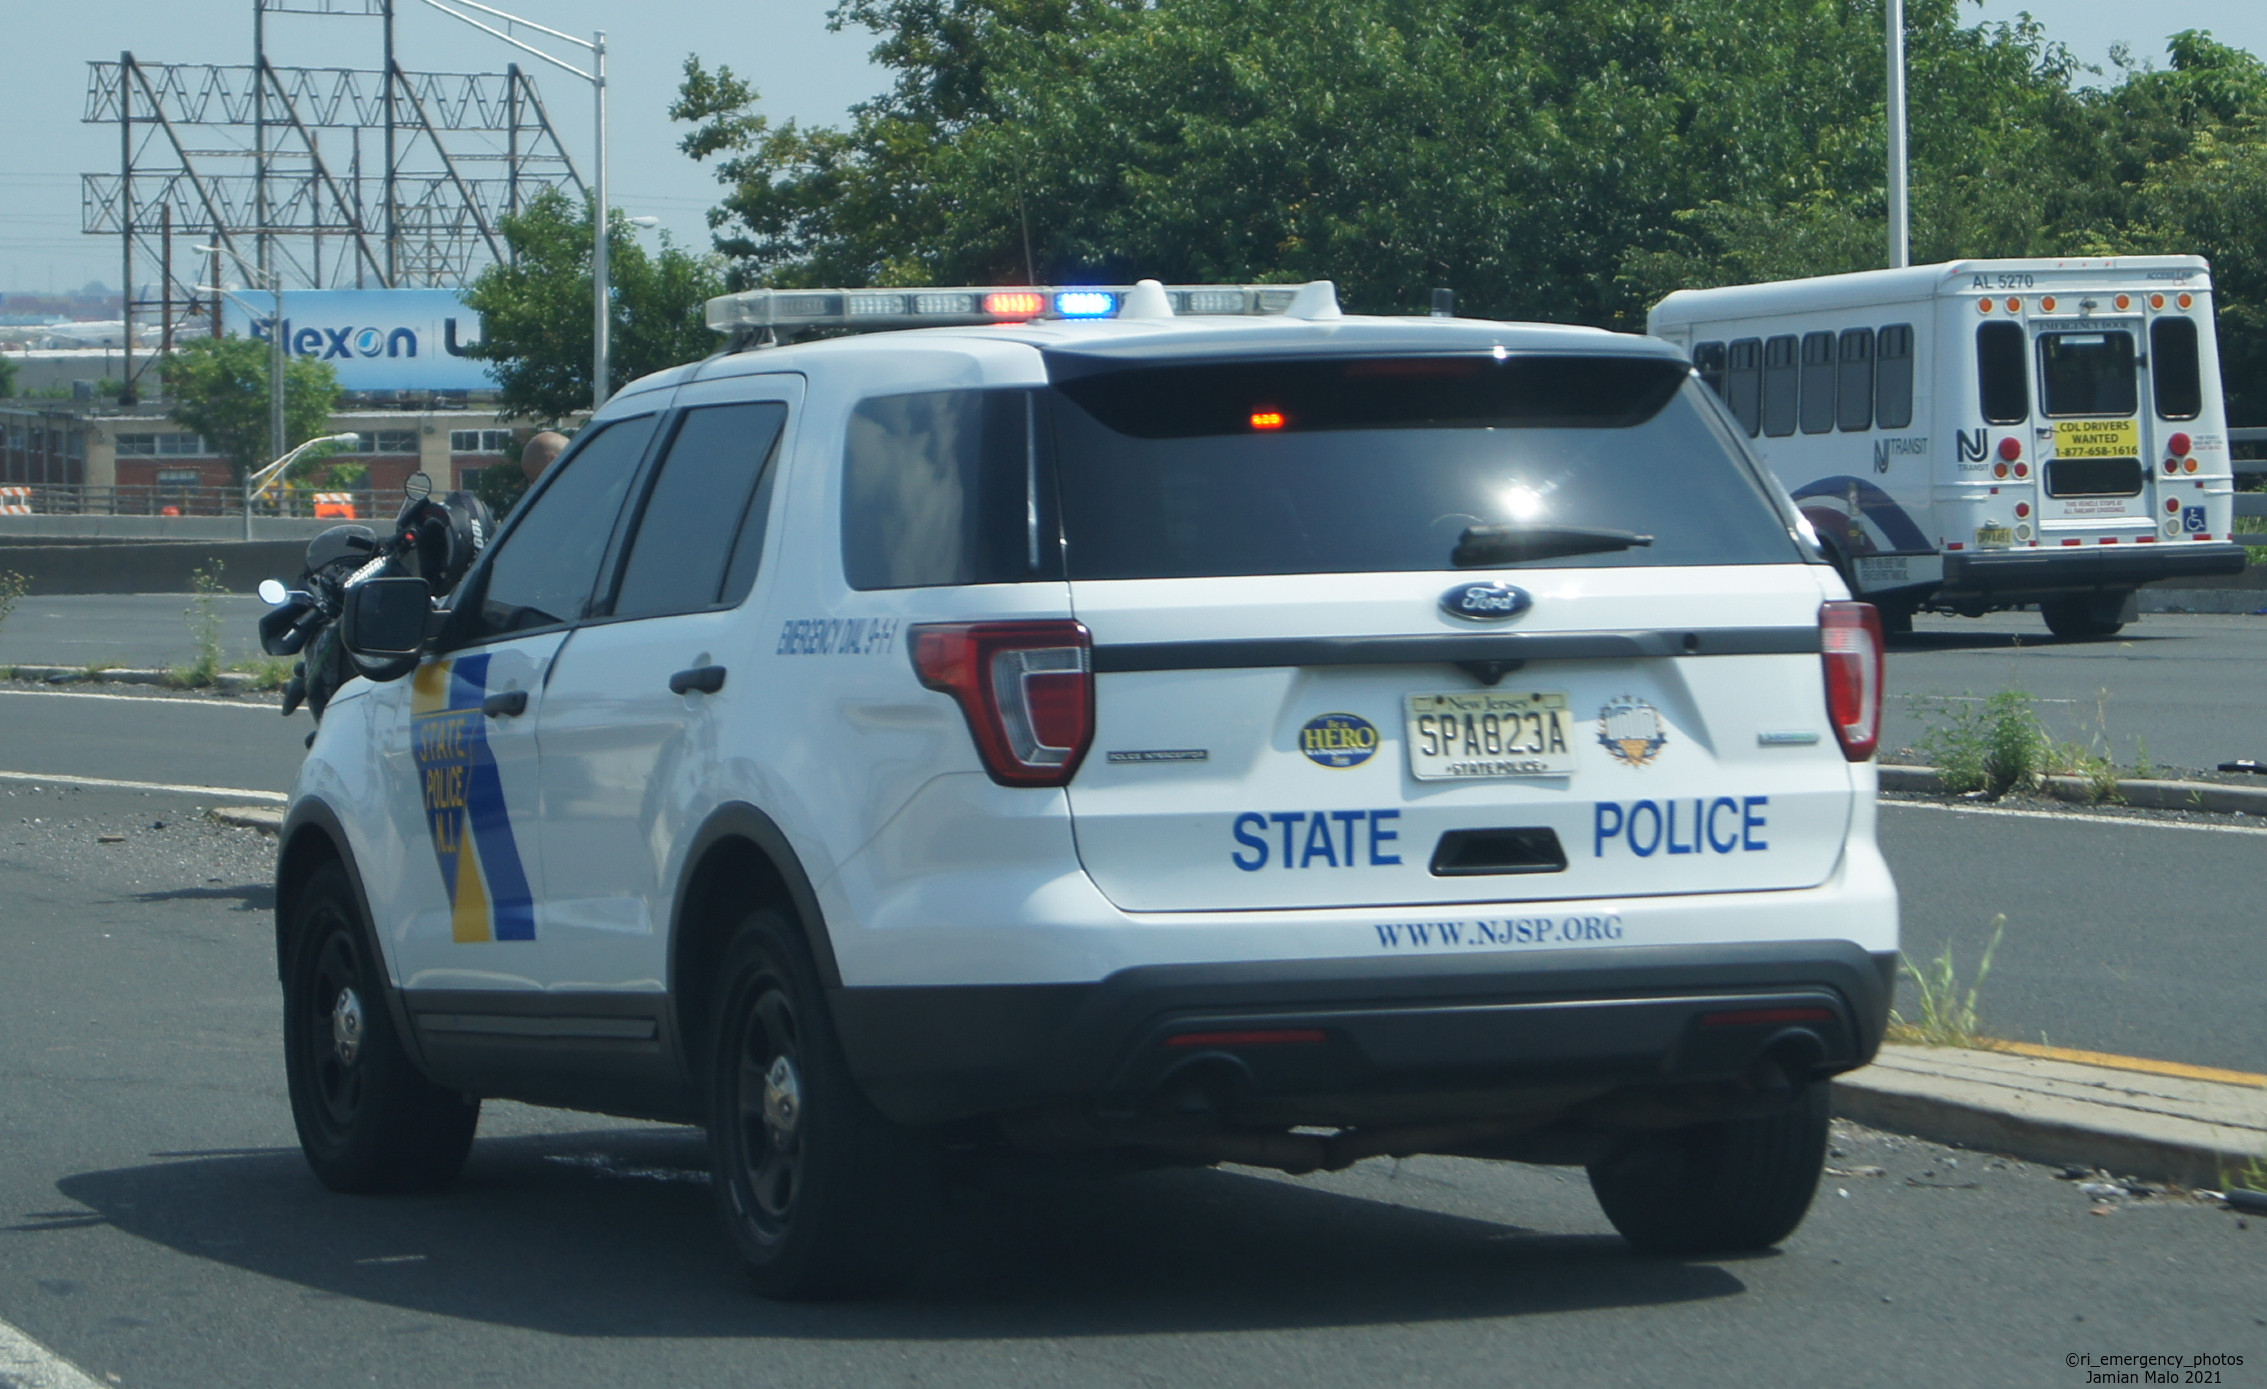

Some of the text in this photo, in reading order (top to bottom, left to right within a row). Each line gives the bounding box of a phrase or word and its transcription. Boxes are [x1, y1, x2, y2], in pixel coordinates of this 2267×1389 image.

[1972, 274, 2034, 289] AL 5270
[2060, 421, 2129, 432] CDL DRIVERS
[1890, 438, 1928, 454] TRANSIT
[2072, 434, 2118, 444] WANTED
[2055, 445, 2138, 457] 1-877-658-1616
[1461, 587, 1516, 609] Ford
[420, 718, 466, 762] STATE
[1303, 727, 1376, 749] HERO
[1418, 711, 1567, 756] SPA823A
[1452, 759, 1543, 775] STATE POLICE
[426, 766, 464, 809] POLICE
[1231, 796, 1769, 872] STATE POLICE
[1374, 916, 1623, 948] WWW.NJSP.ORG
